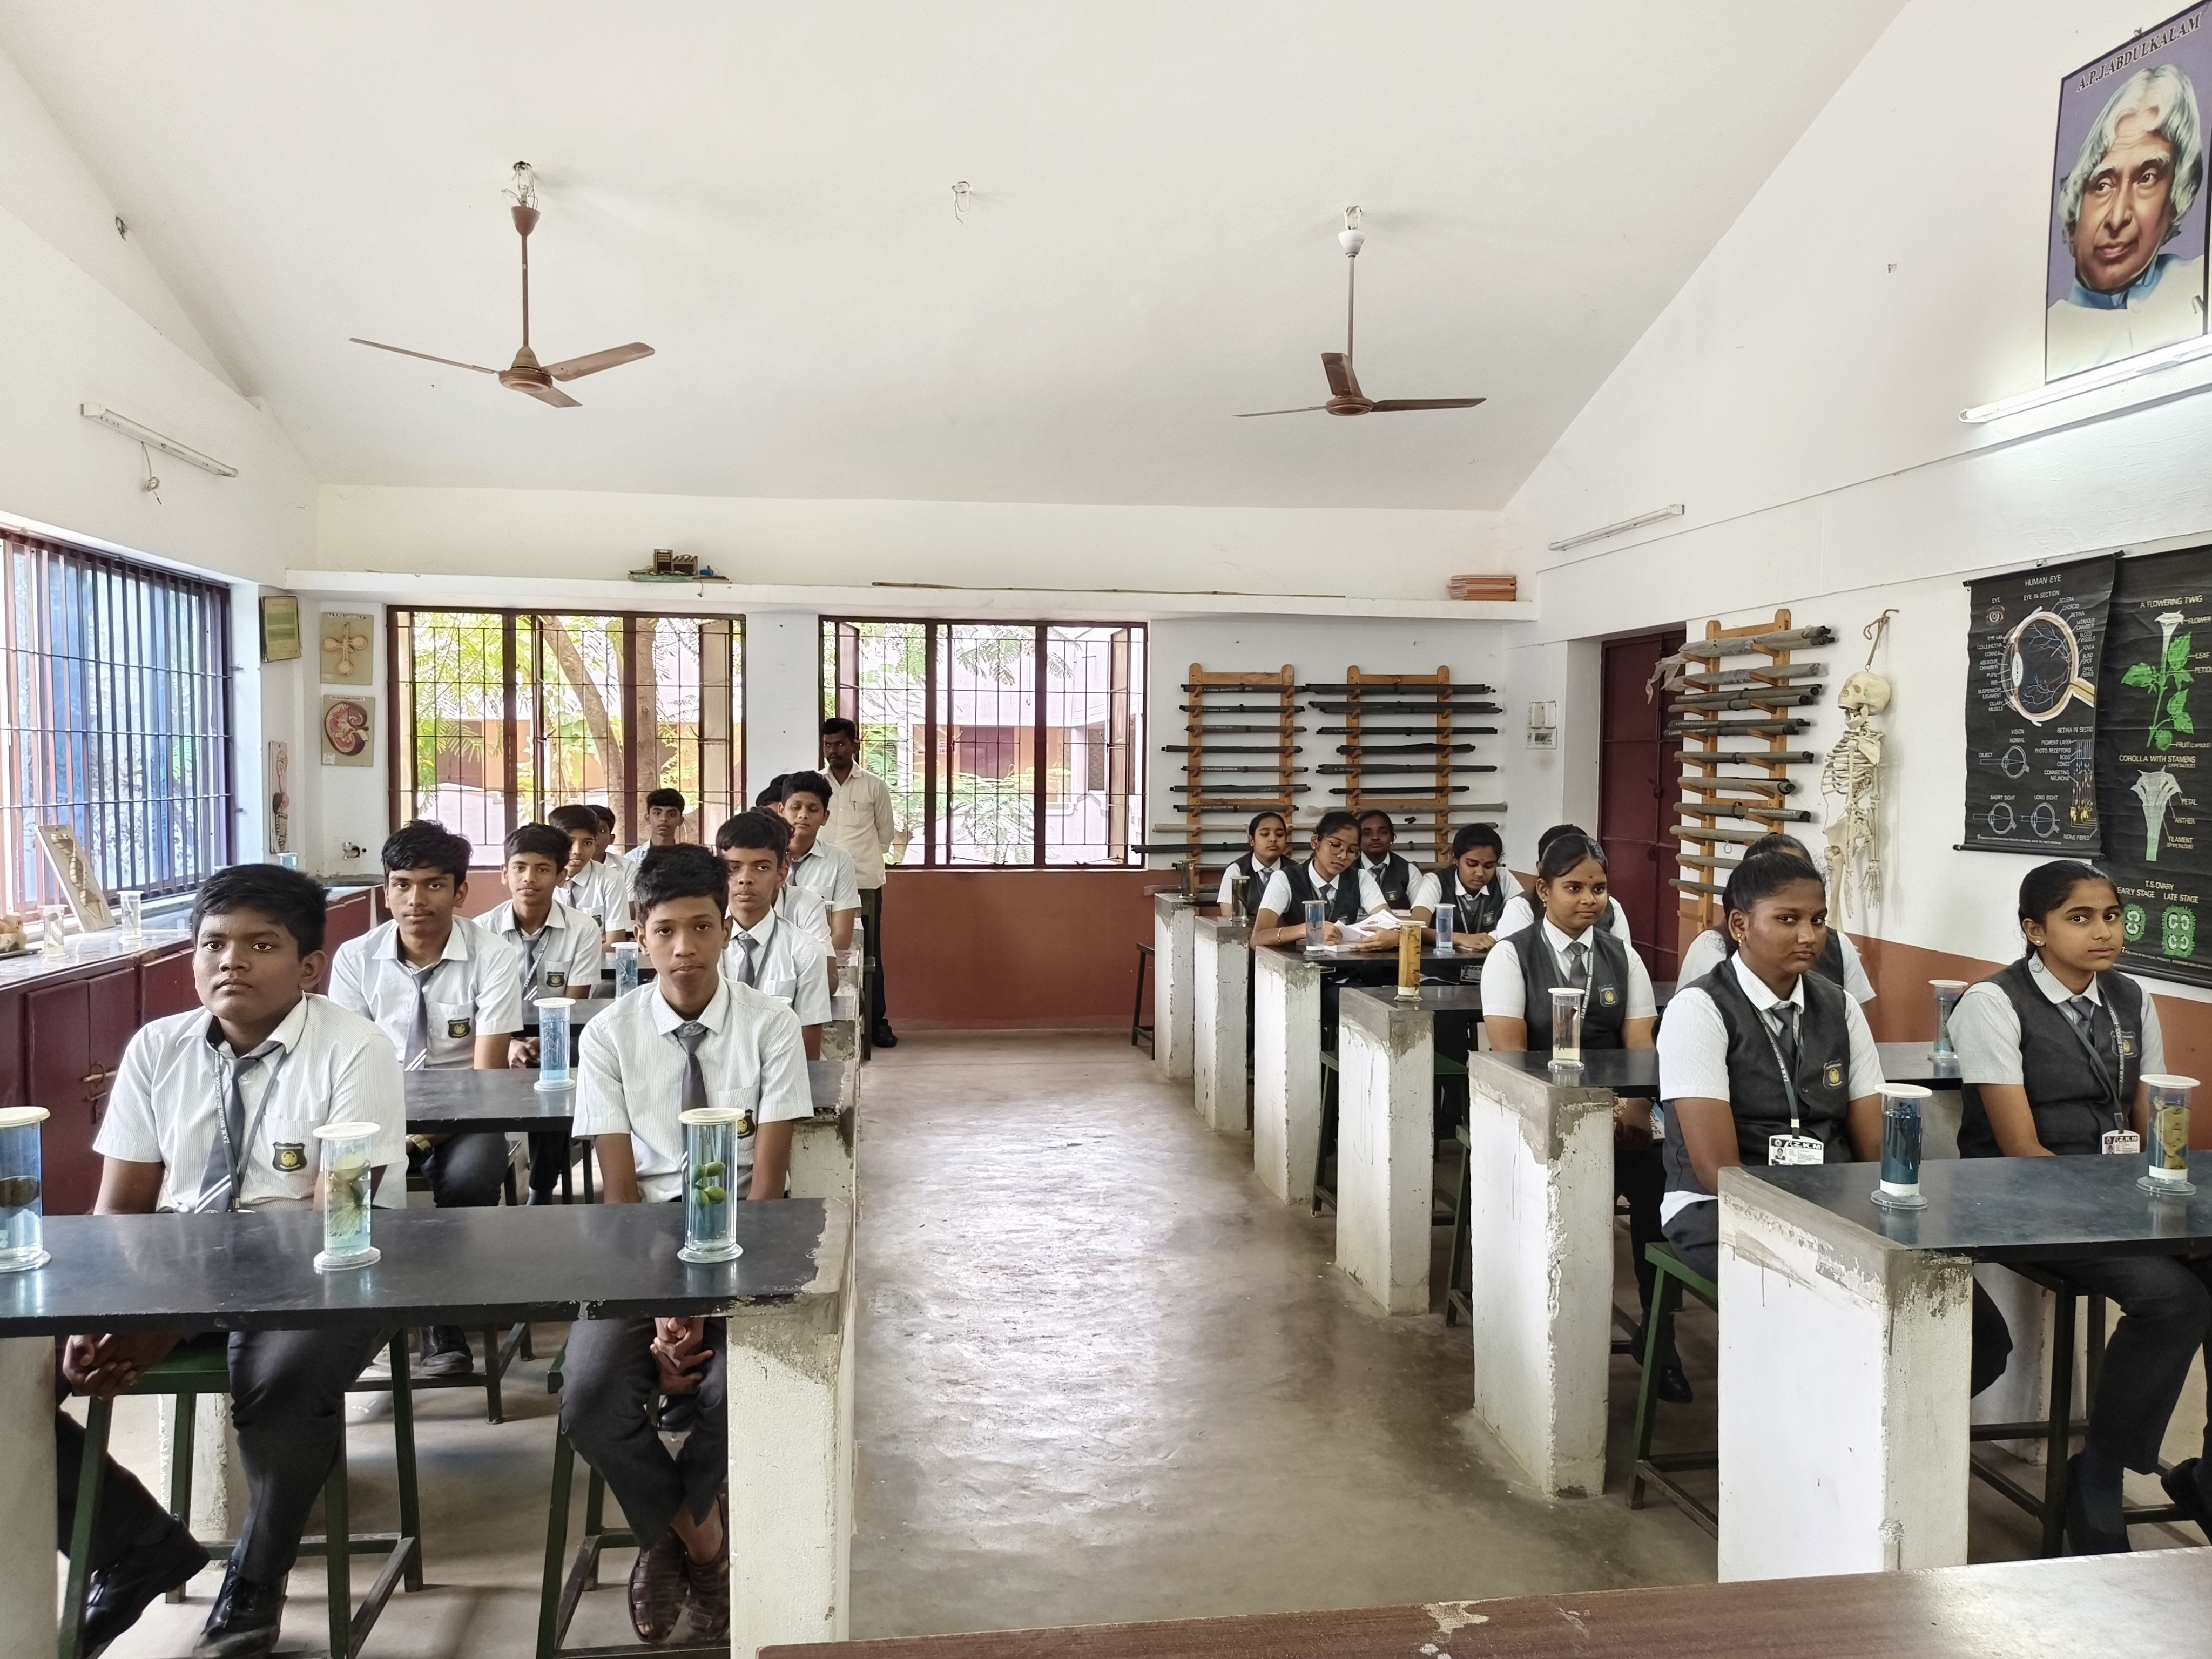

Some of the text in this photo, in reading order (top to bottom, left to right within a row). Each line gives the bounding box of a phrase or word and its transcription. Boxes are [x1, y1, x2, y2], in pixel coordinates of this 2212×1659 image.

[2025, 574, 2061, 586] HUMAN EYE
[2040, 590, 2060, 599] SECTION
[2147, 597, 2182, 608] FLOWERING
[2184, 595, 2202, 604] TWIG
[2117, 887, 2155, 898] EARLY STAGE
[2163, 893, 2199, 903] LATE STAGE
